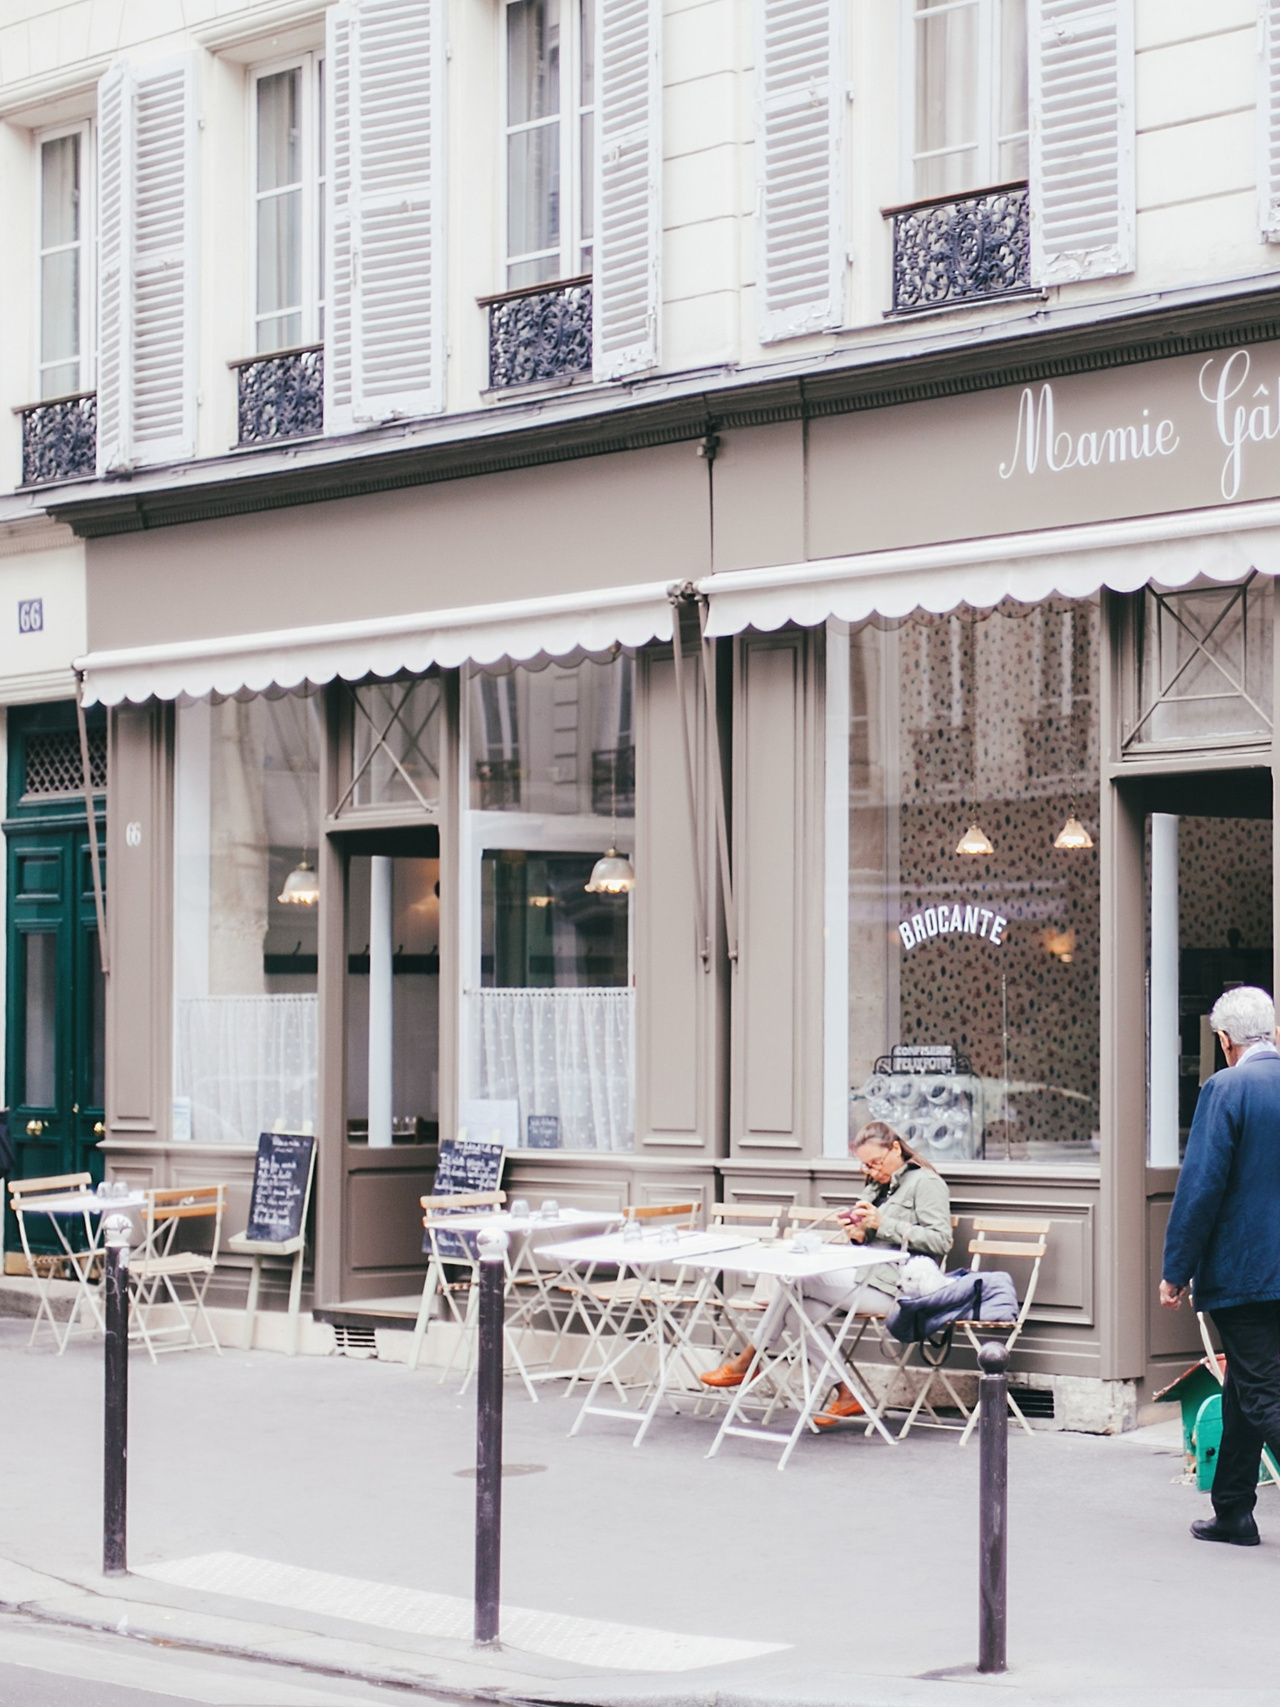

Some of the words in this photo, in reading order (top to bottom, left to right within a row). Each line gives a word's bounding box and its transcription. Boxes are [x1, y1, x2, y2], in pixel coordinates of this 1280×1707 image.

[999, 383, 1180, 479] Mamie
[20, 601, 41, 632] 66
[126, 821, 142, 847] 66
[898, 904, 1007, 950] BROCANTE
